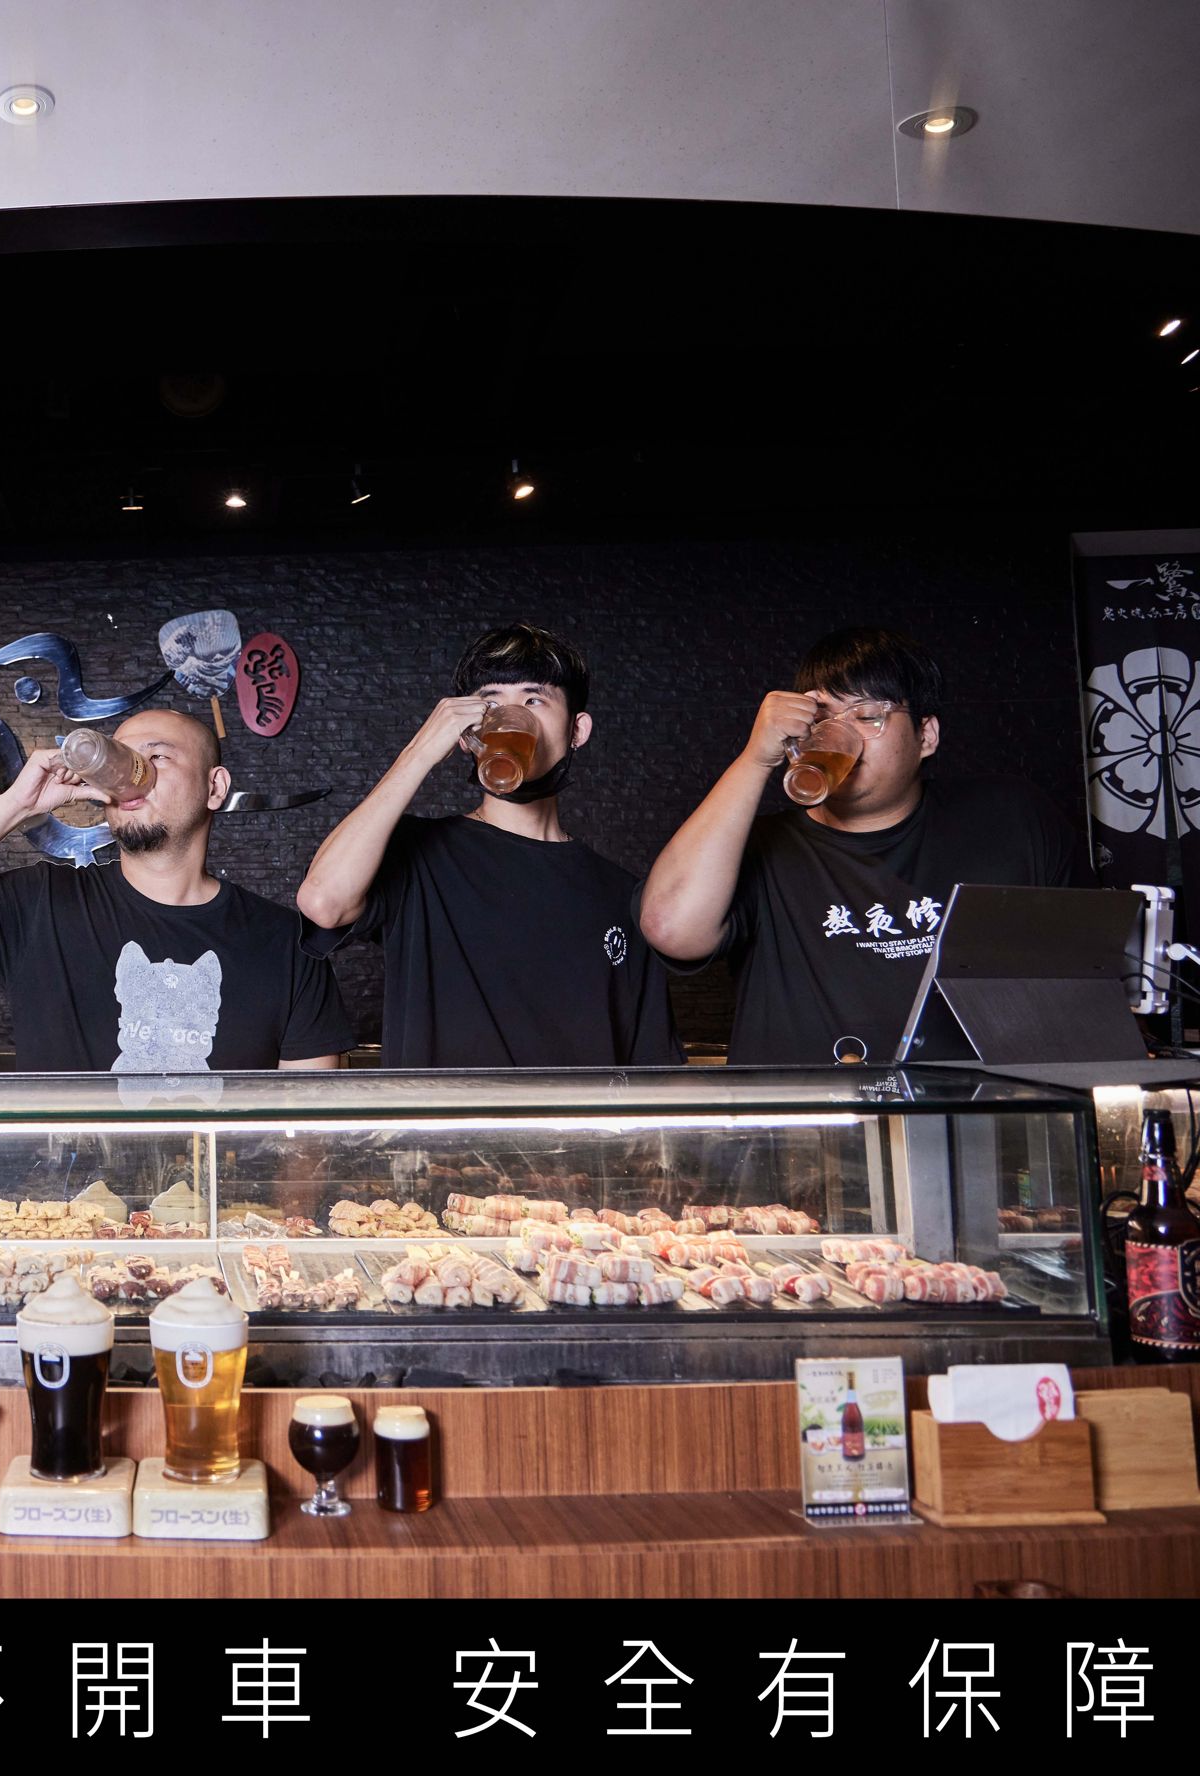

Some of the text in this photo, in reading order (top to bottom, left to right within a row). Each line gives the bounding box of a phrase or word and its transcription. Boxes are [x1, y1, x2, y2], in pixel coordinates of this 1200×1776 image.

[888, 939, 908, 947] STAY
[908, 937, 917, 945] UP
[917, 935, 935, 944] LATE
[906, 949, 924, 957] STOP
